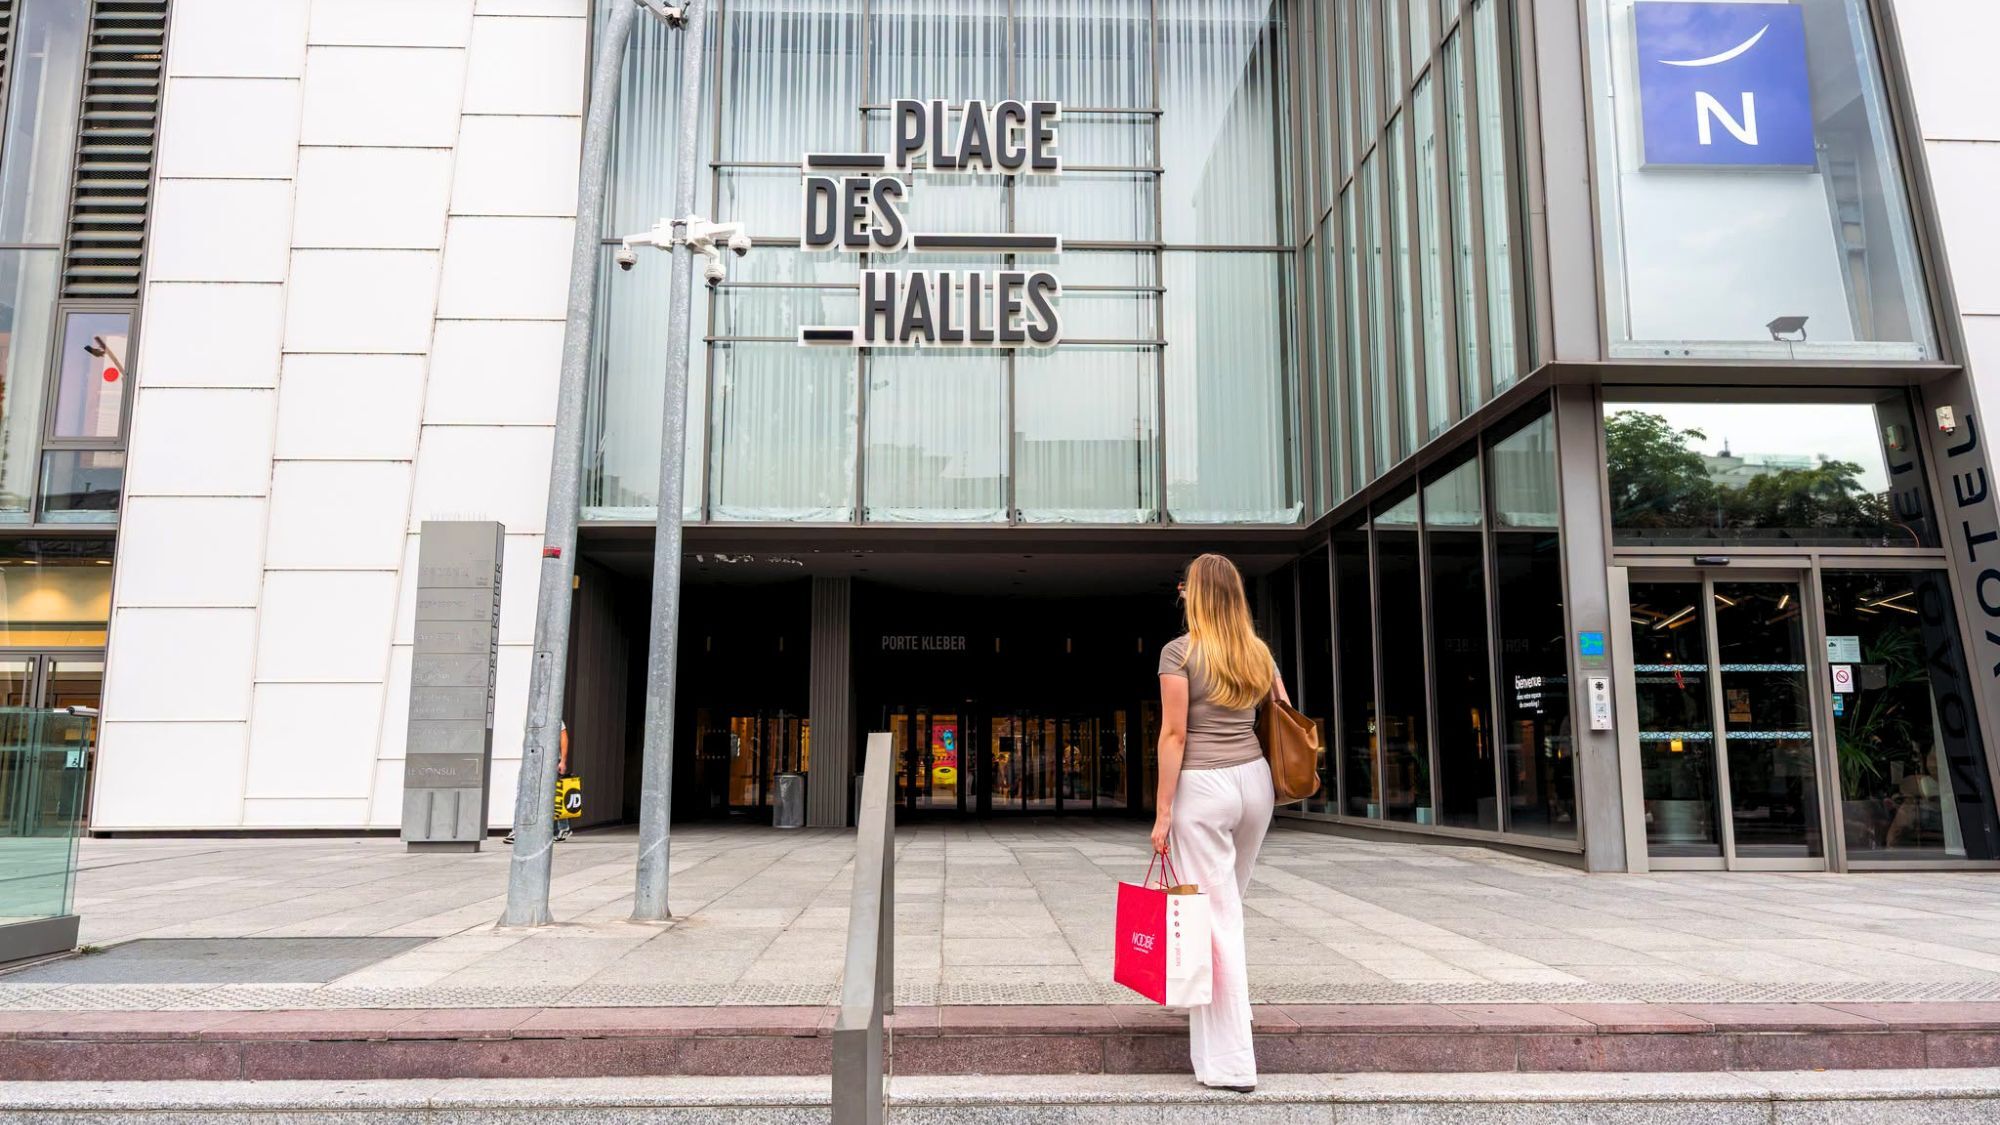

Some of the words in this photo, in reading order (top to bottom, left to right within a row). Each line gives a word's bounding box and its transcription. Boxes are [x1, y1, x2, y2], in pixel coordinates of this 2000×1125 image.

[896, 100, 1058, 169] PLACE
[1695, 91, 1758, 146] N
[806, 177, 903, 248] DES
[864, 271, 1059, 343] HALLES
[491, 562, 502, 629] KLEBER
[487, 637, 498, 699] PORTE
[881, 635, 919, 650] PORTE
[921, 635, 966, 650] KLEBER
[419, 767, 457, 776] CONSUL
[566, 793, 582, 809] JD
